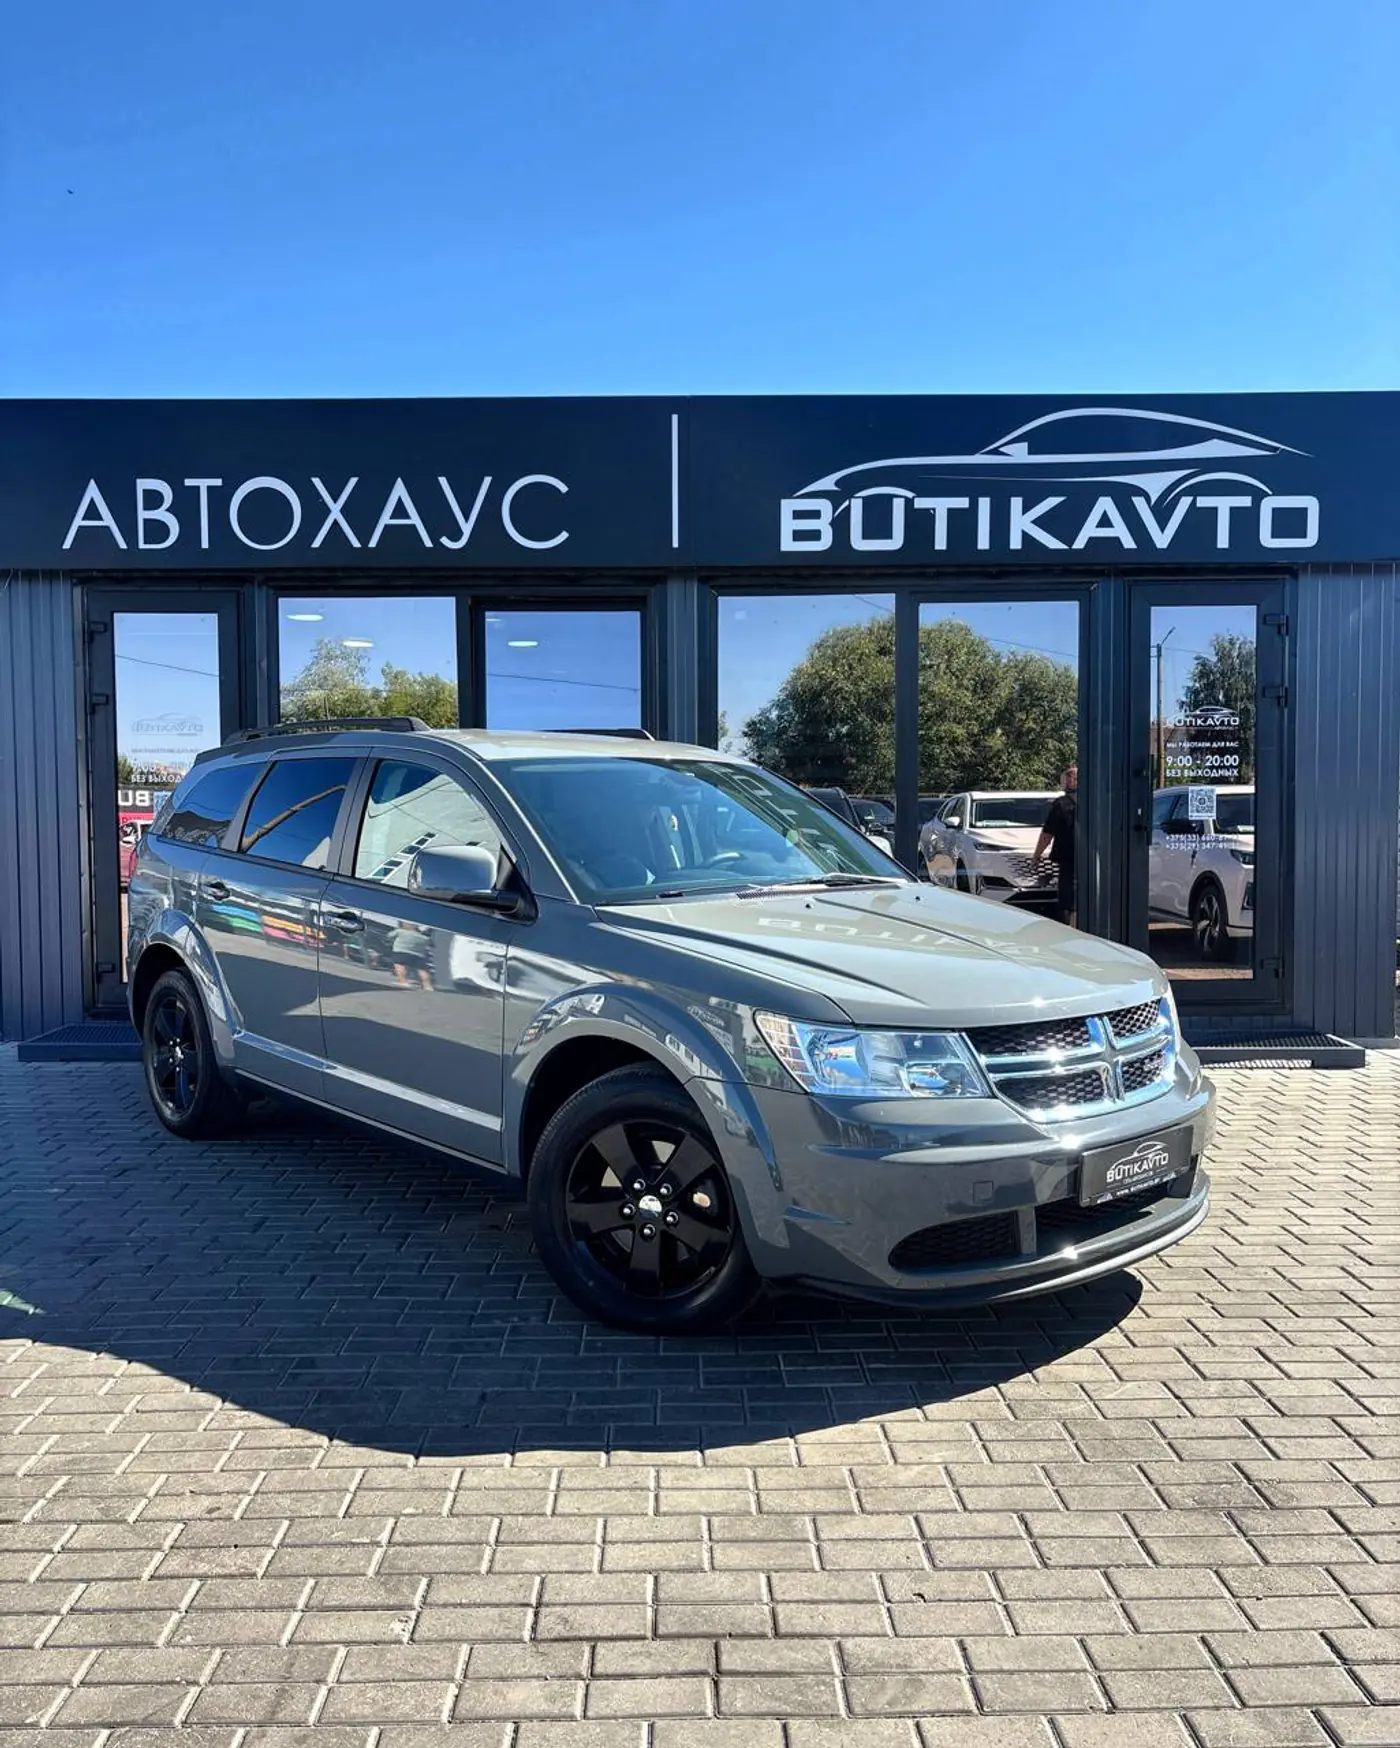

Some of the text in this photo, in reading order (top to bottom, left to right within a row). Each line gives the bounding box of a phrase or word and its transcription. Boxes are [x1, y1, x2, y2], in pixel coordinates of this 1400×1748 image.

[62, 474, 570, 551] АВТОХАУС
[780, 495, 1321, 552] BUTIKAVTO
[1166, 755, 1193, 766] 9:00
[1205, 755, 1239, 766] 20:00
[148, 774, 184, 783] ВЫХОД
[1166, 768, 1239, 777] БЕЗ ВЫХОДНЫХ
[1105, 1152, 1169, 1183] BUTIKAVTO
